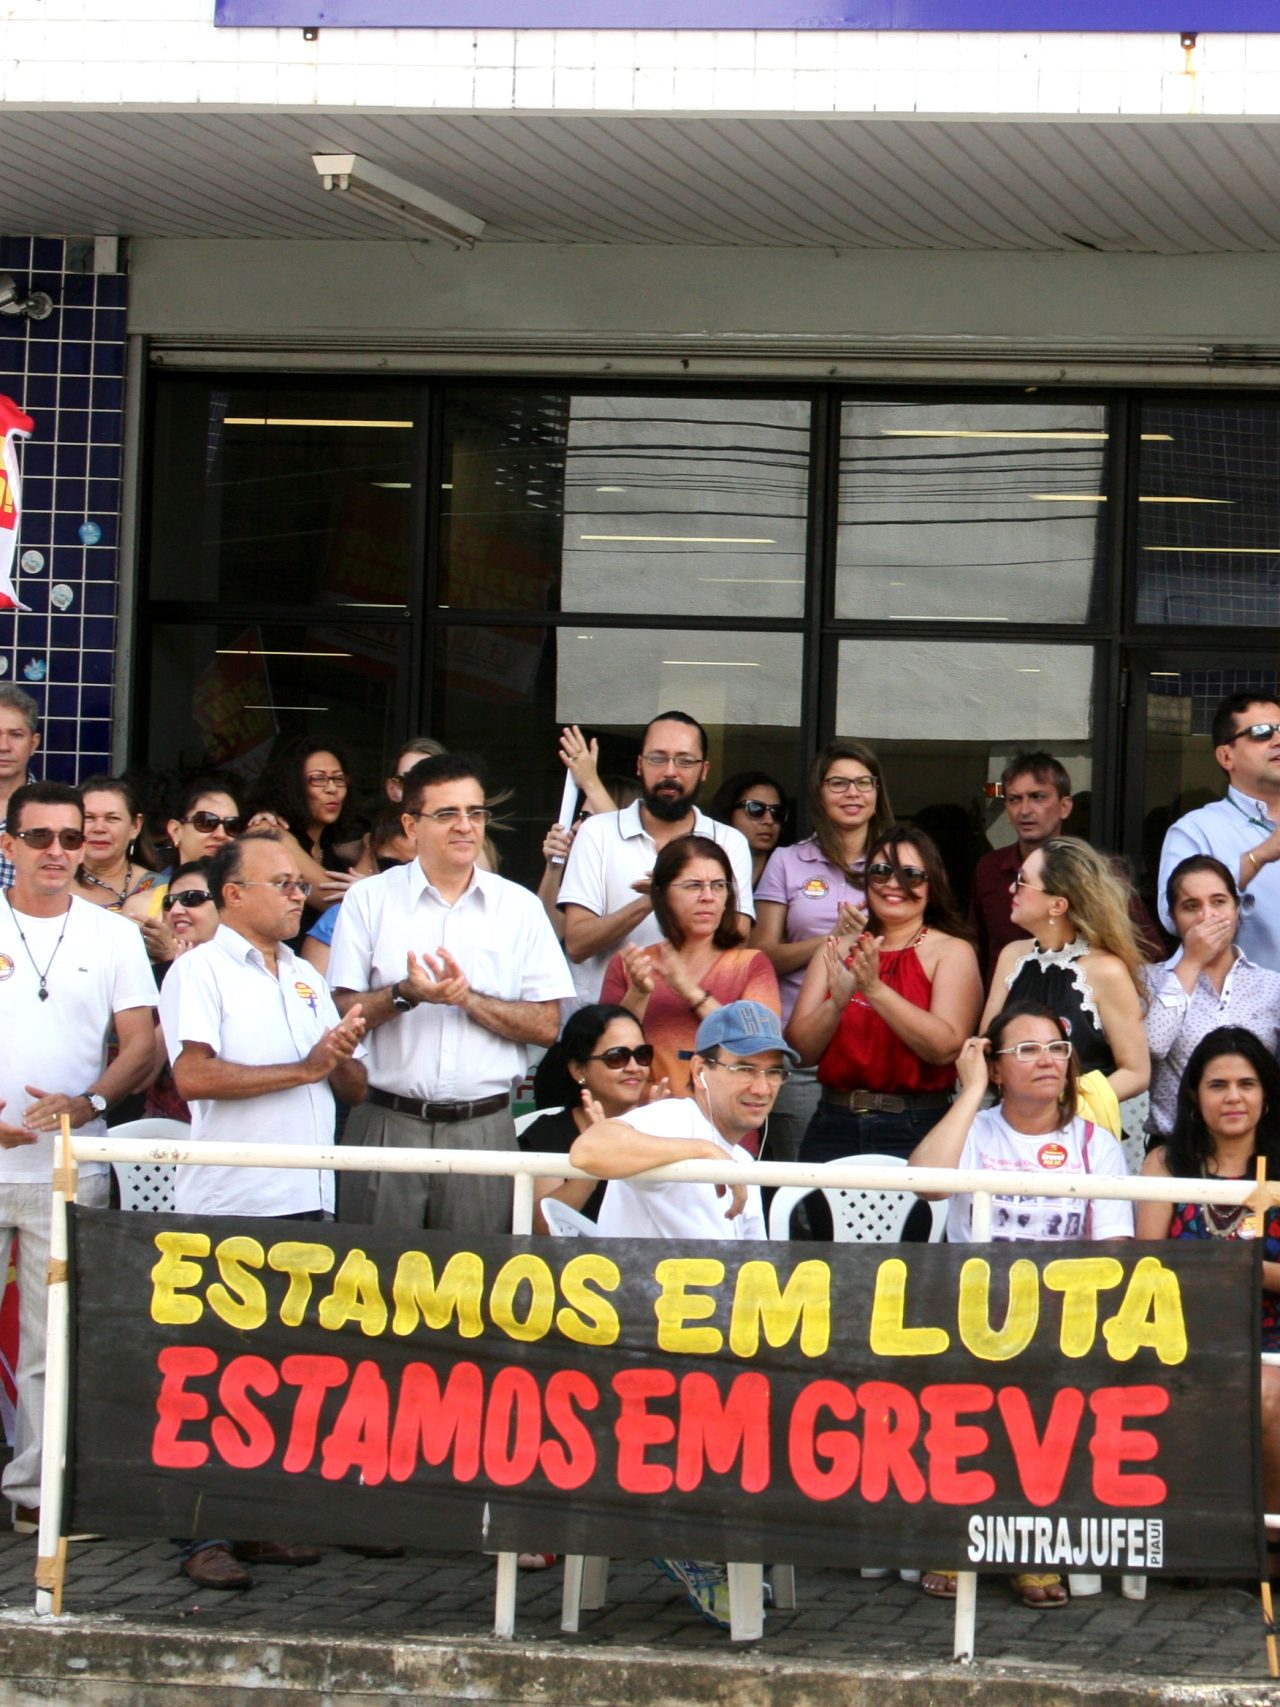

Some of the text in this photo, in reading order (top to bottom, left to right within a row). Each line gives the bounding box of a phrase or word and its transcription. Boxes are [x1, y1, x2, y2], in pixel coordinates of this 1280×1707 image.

[150, 1231, 1188, 1366] ESTAMOS EM LUTA
[151, 1345, 1170, 1507] ESTAMOS EM GREVE
[967, 1514, 1145, 1568] SINTRAJUFE
